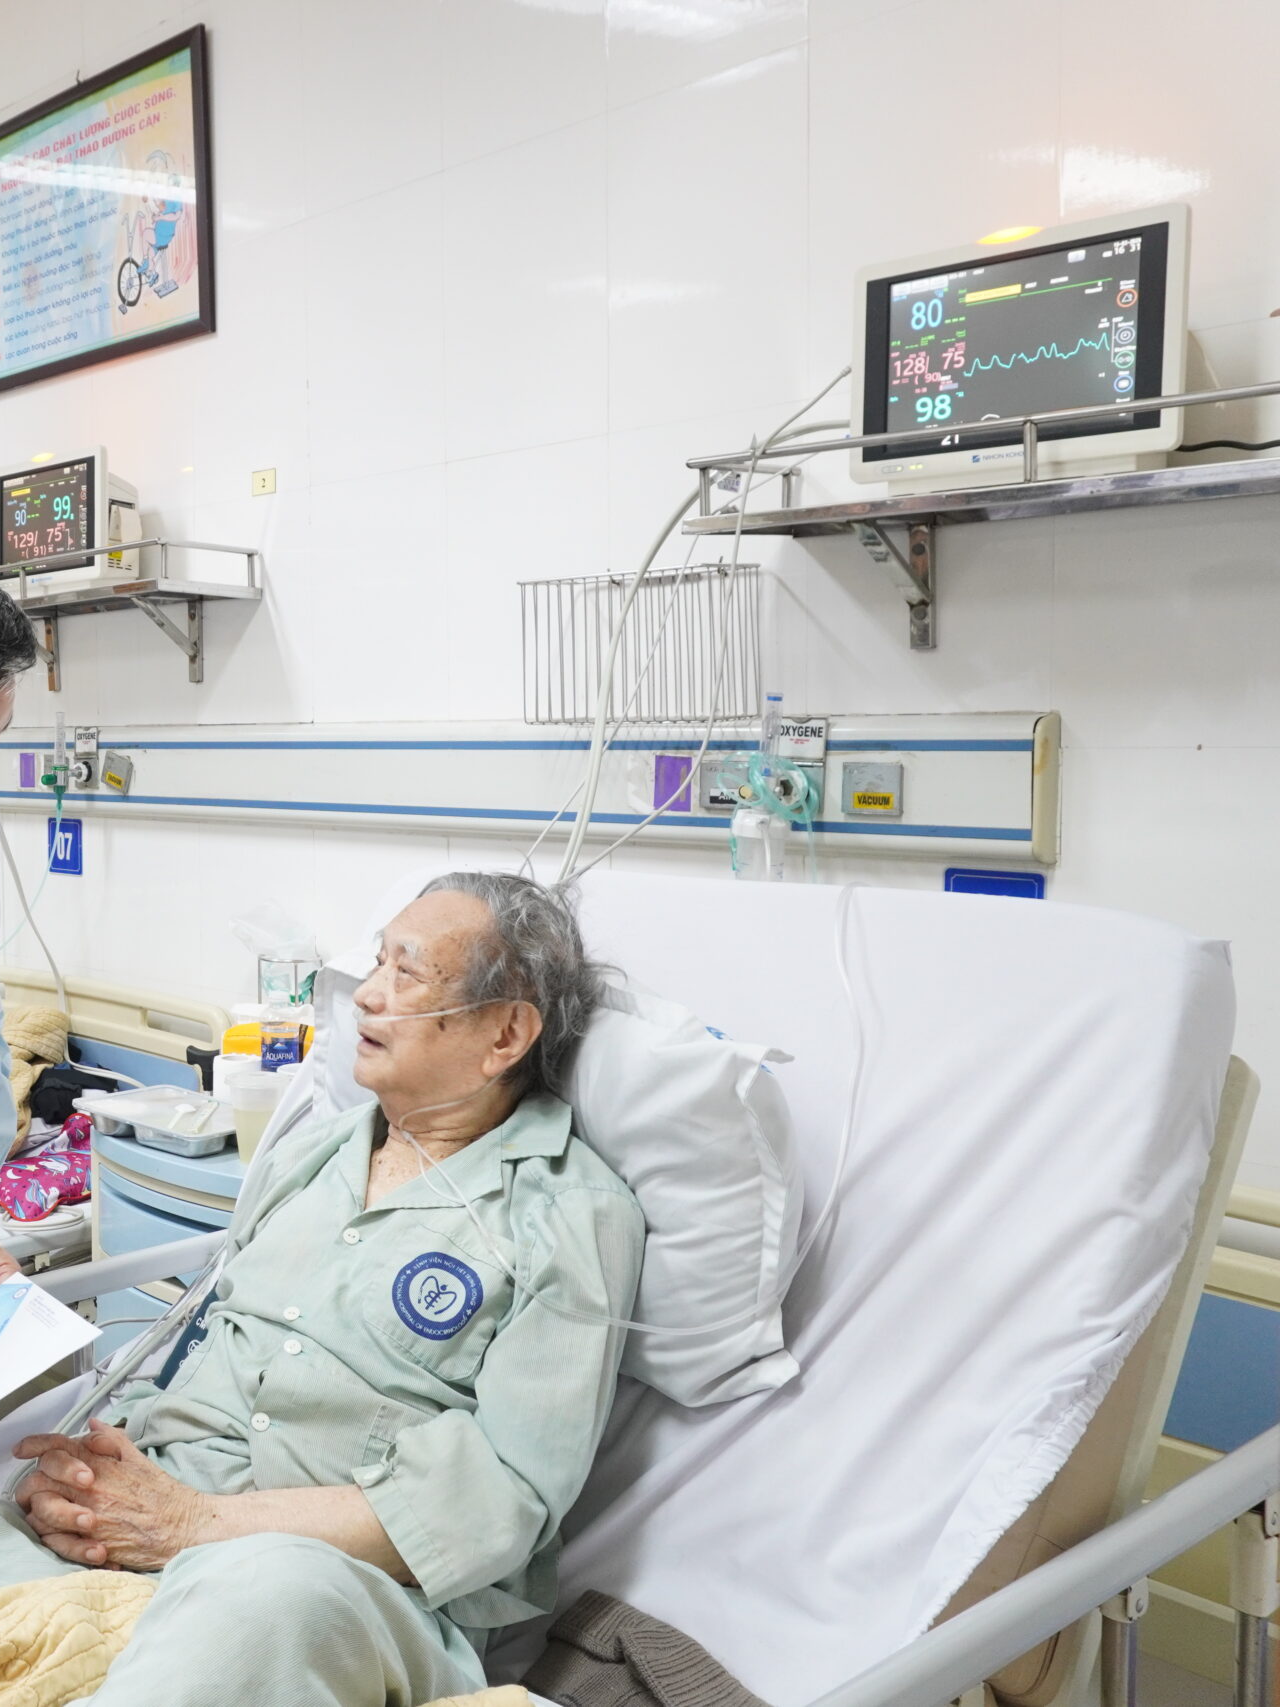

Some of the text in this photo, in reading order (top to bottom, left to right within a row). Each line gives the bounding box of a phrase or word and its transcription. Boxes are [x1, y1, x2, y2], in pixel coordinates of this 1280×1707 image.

[113, 102, 140, 125] CUỘC
[911, 298, 943, 331] 80
[942, 350, 965, 371] 75
[915, 394, 952, 423] 98
[15, 509, 27, 526] 90
[53, 495, 71, 521] 99
[46, 527, 62, 543] 75
[857, 795, 890, 806] VACUUM
[57, 831, 73, 861] 07
[266, 1051, 294, 1062] AQUAFINA
